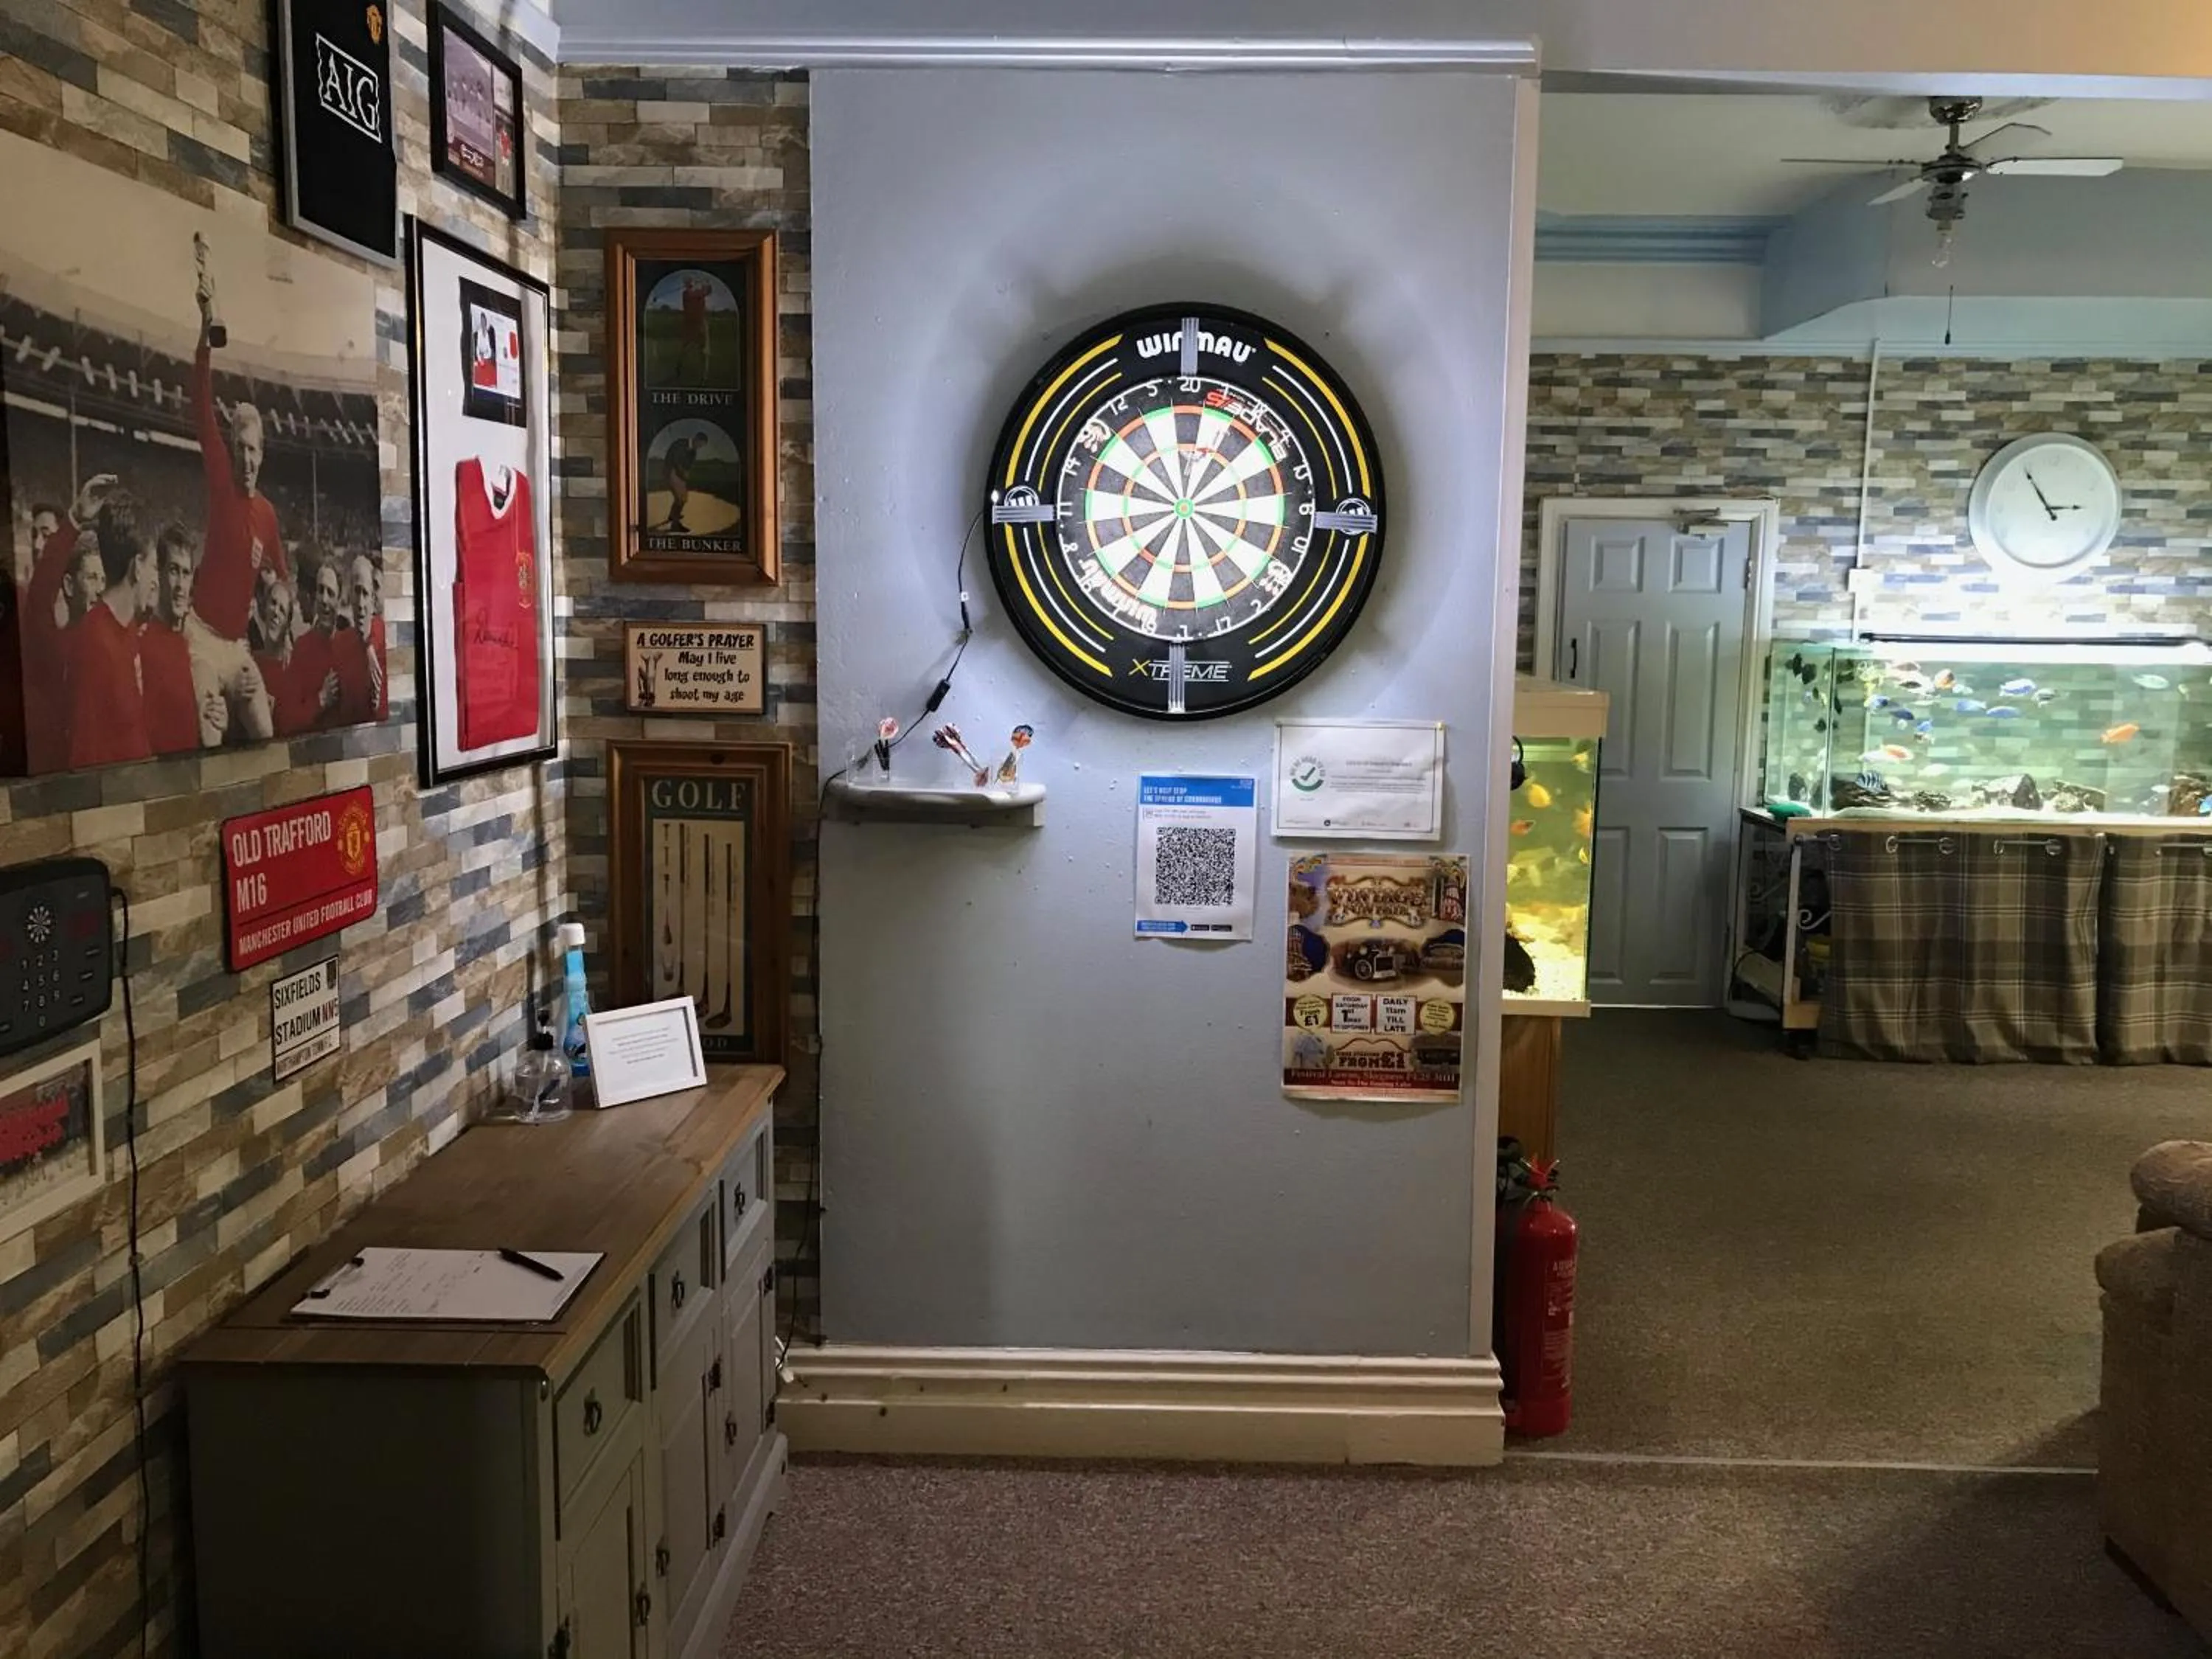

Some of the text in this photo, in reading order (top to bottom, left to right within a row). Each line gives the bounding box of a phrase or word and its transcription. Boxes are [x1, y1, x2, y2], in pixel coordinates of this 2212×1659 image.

[324, 52, 375, 131] AIG
[1146, 383, 1158, 397] 5
[1180, 378, 1201, 393] 20
[652, 392, 733, 405] THE DRIVE
[1107, 395, 1129, 416] 12
[1064, 456, 1082, 476] 14
[648, 538, 742, 552] THE BUNKER
[637, 632, 754, 647] A GOLFER'S PRAYER
[678, 650, 737, 667] May I live
[664, 667, 750, 684] long enough to
[669, 687, 745, 703] shoot my age
[651, 779, 746, 810] GOLF
[232, 810, 332, 868] OLD TRAFFORD
[236, 872, 267, 914] M16
[238, 921, 291, 956] MANCHESTER
[293, 910, 319, 933] UNITED
[320, 897, 355, 924] FOOTBALL
[274, 971, 321, 1009] SIXFIELDS
[276, 1006, 321, 1046] STADIUM
[1339, 1051, 1405, 1068] FROM £1
